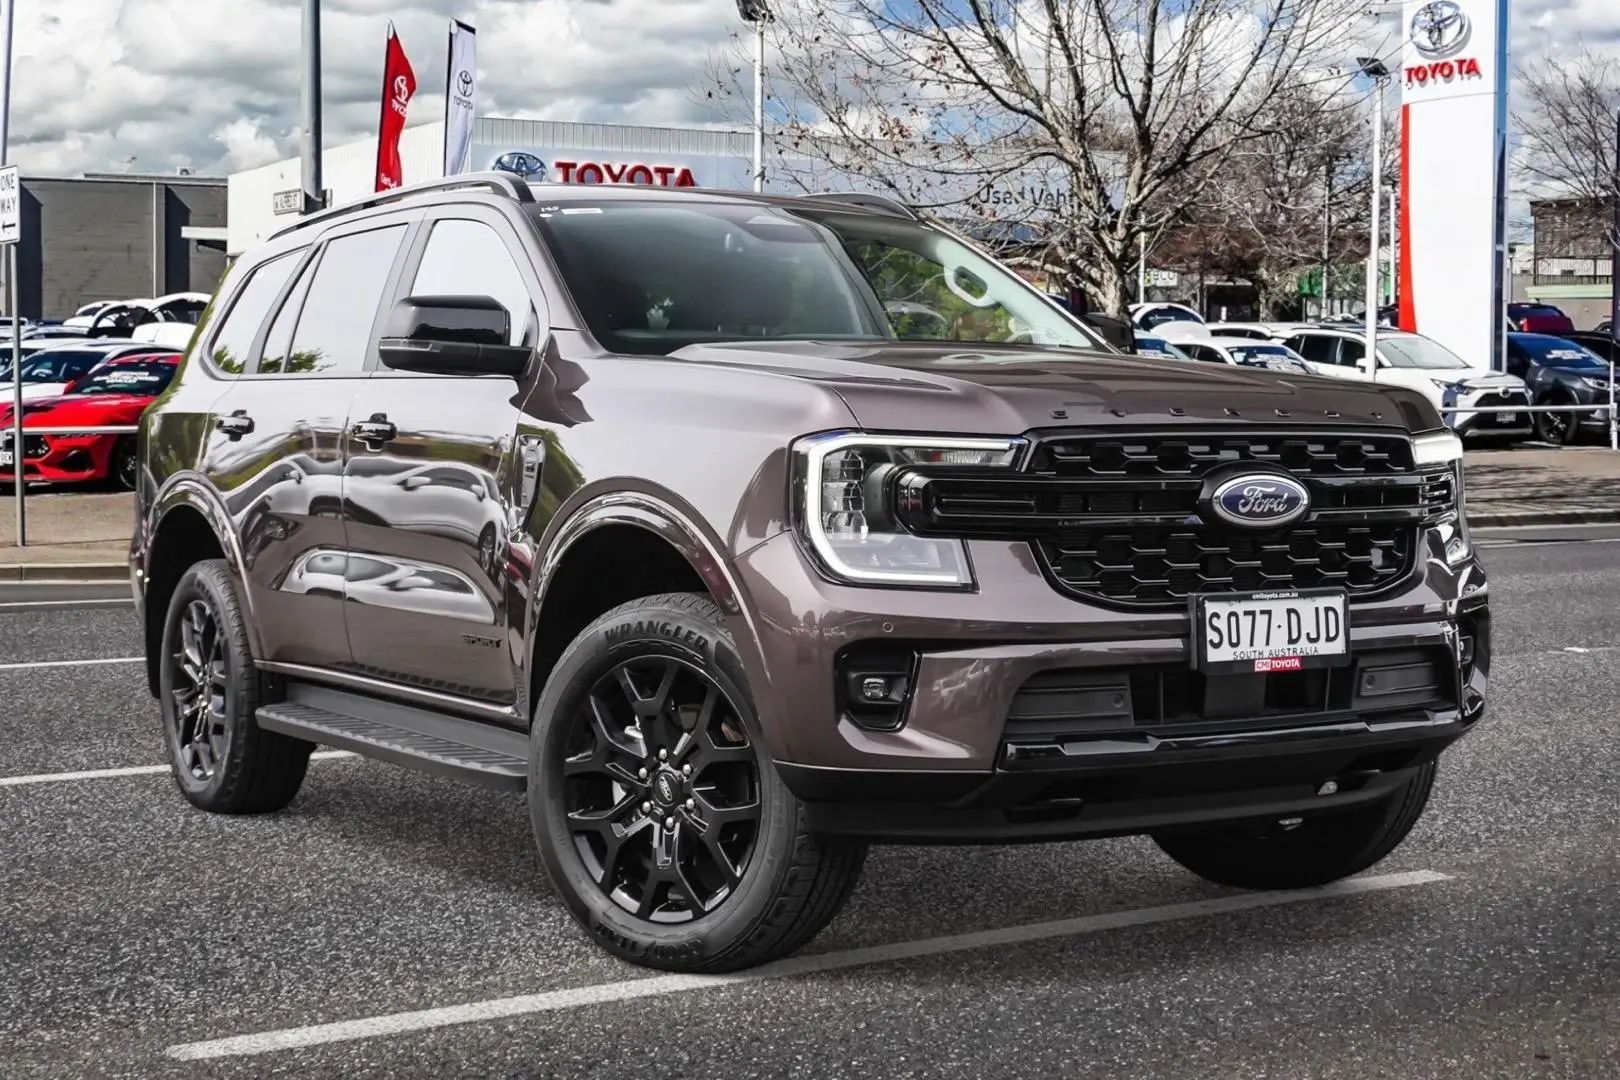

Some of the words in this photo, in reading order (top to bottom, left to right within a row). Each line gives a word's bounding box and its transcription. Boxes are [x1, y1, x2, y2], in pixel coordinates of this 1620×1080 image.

[1404, 58, 1481, 83] TOYOTA
[555, 161, 698, 188] TOYOTA
[1238, 486, 1288, 513] Ford
[1252, 592, 1299, 600] cmitoyota.com.au
[604, 620, 709, 649] WRANGLER
[1233, 649, 1265, 661] SOUTH
[1268, 646, 1319, 658] AUSTRALIA
[1272, 658, 1300, 669] TOYOTA
